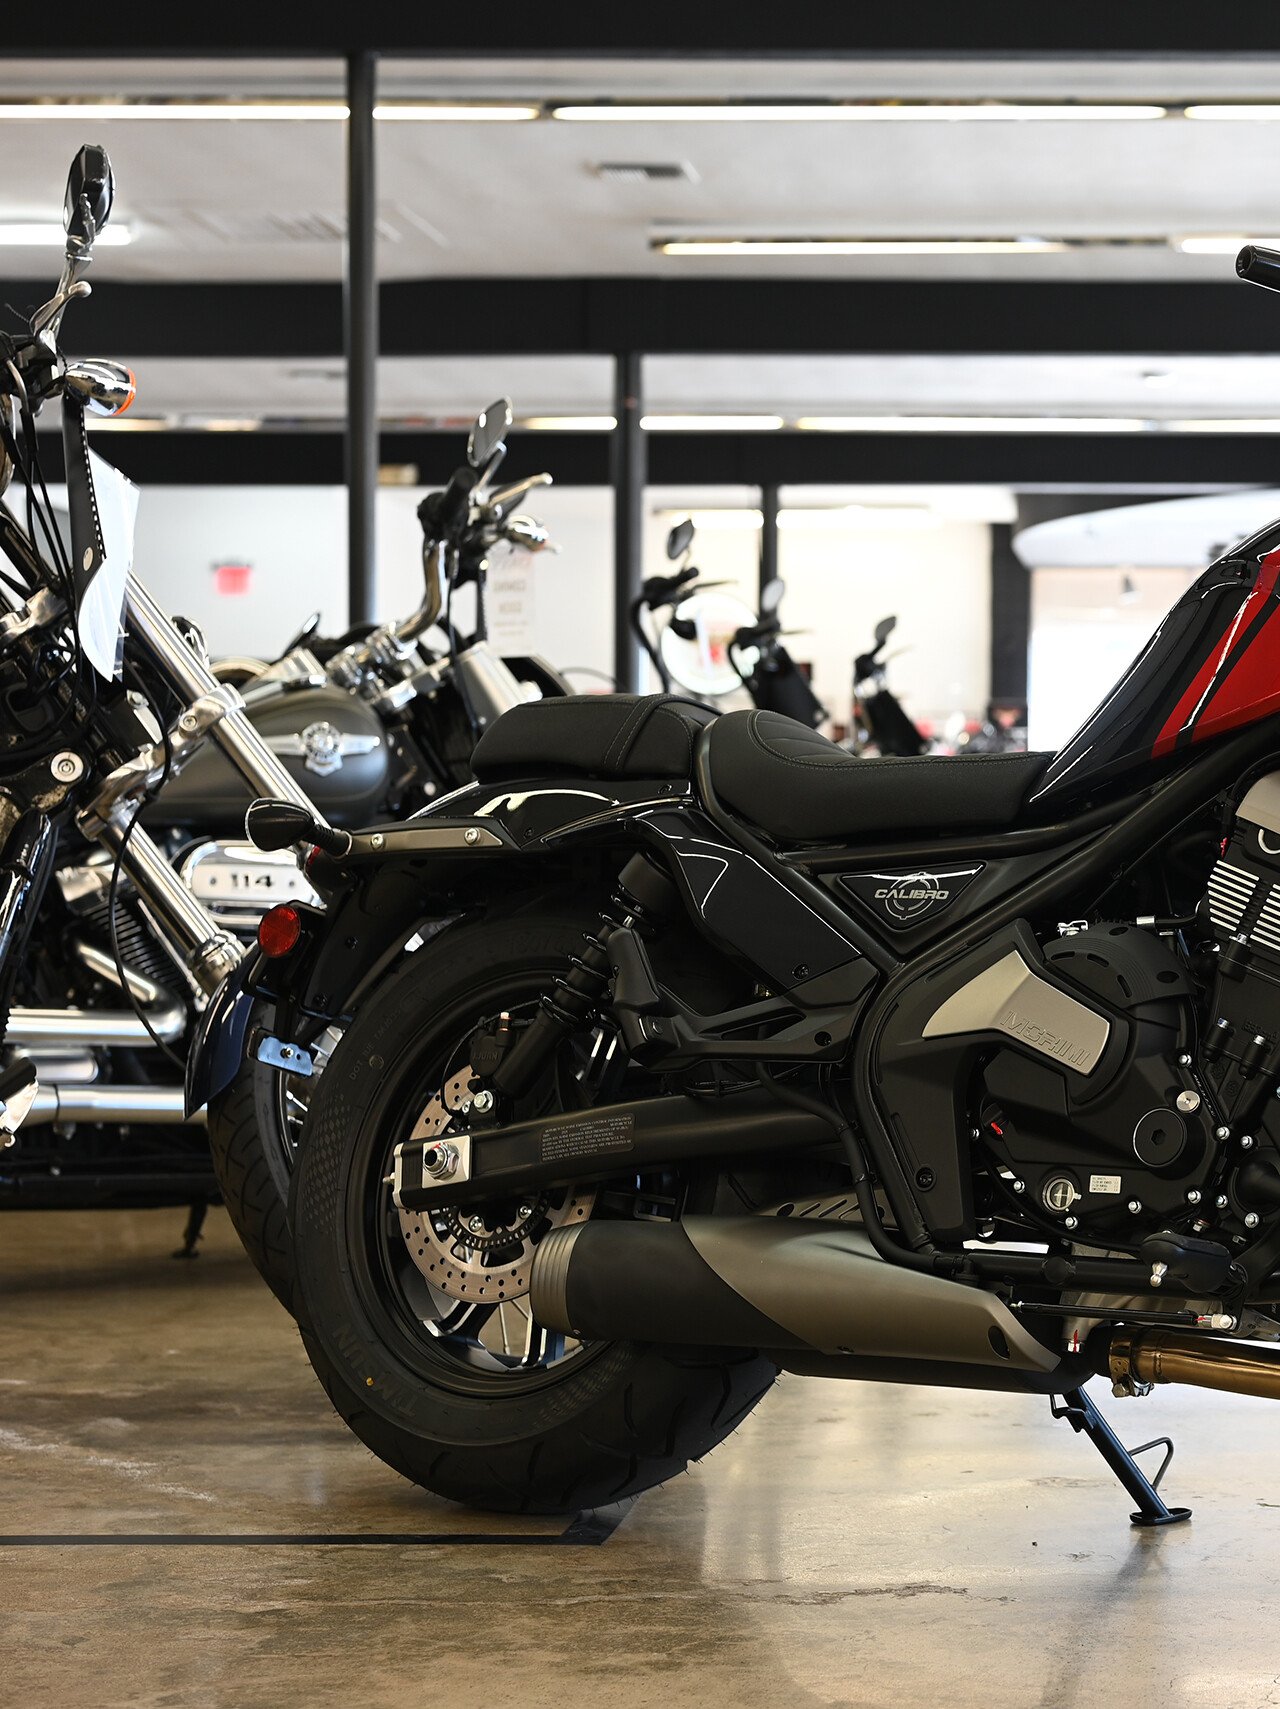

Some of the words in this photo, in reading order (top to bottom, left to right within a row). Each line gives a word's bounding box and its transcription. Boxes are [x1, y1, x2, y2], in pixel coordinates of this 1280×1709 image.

[231, 874, 274, 888] 114
[874, 889, 950, 900] CALIBRO
[1000, 1009, 1091, 1067] MORINI
